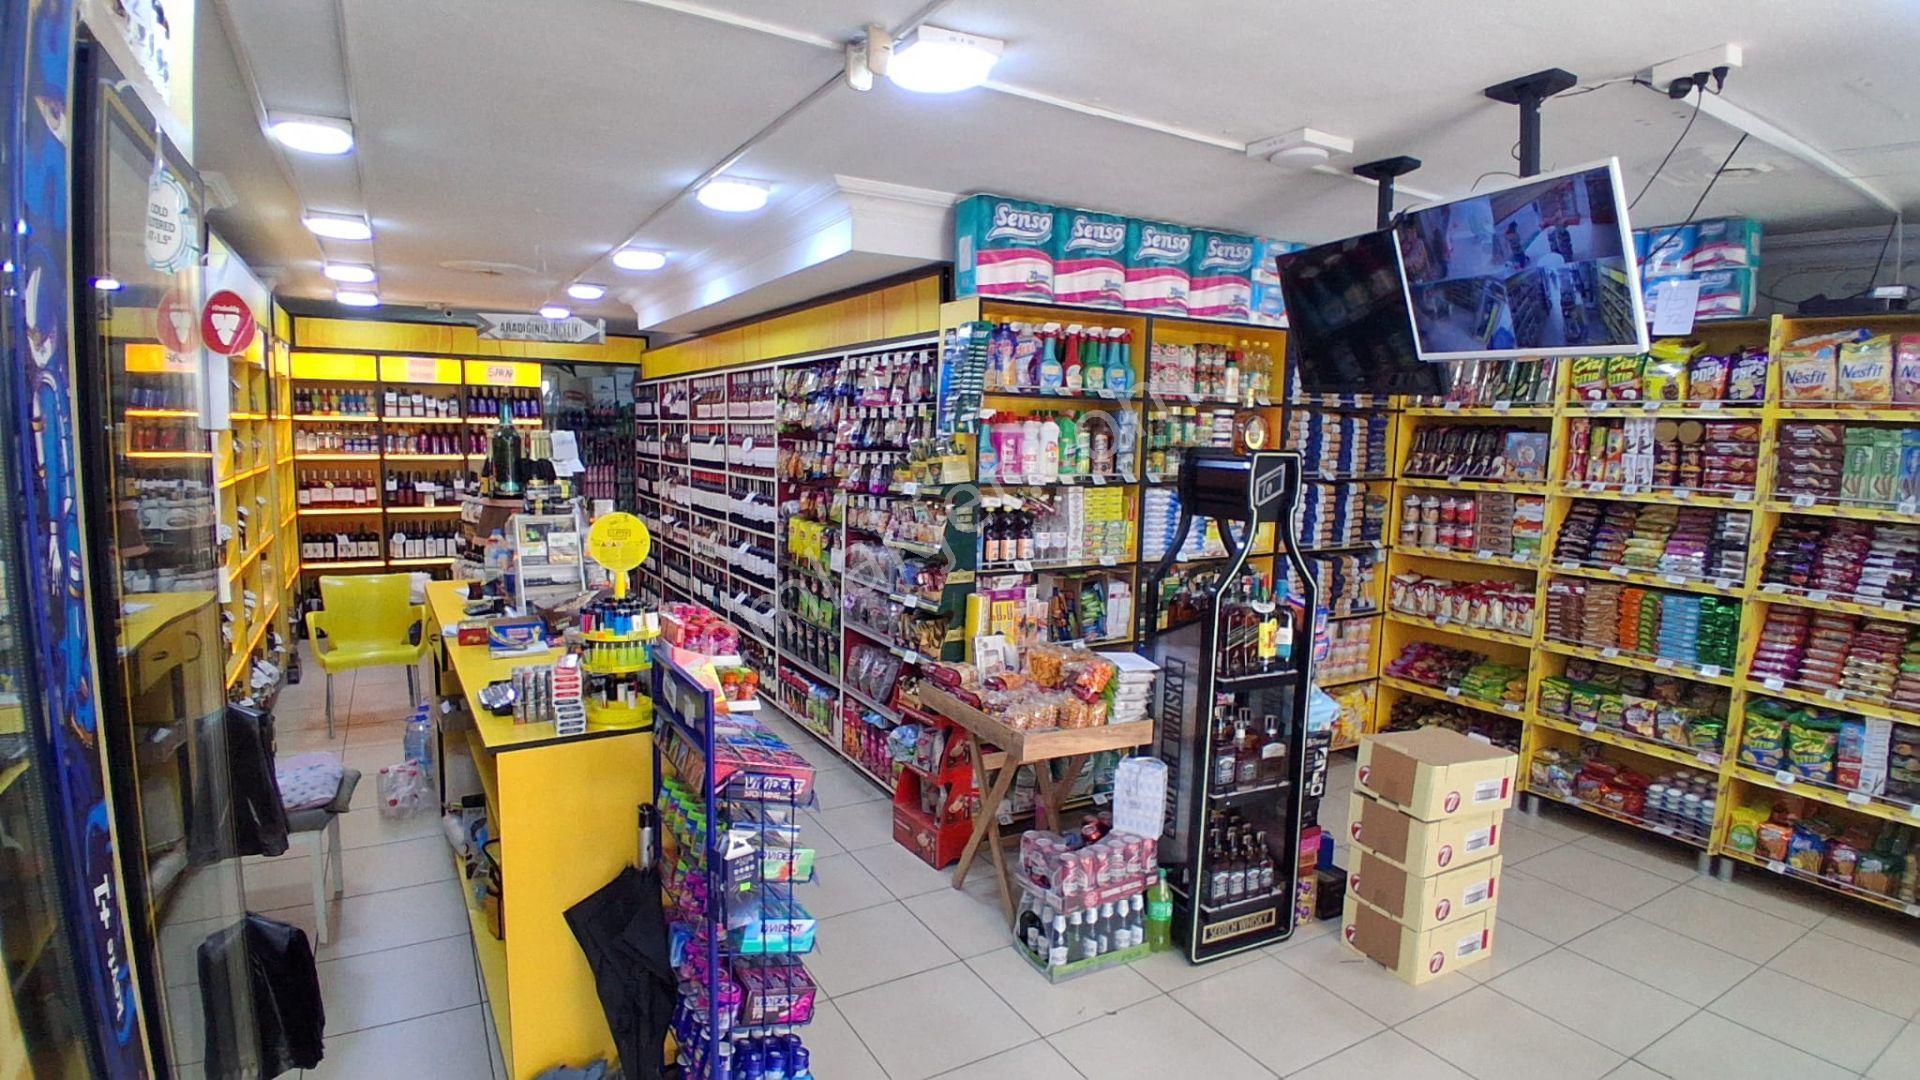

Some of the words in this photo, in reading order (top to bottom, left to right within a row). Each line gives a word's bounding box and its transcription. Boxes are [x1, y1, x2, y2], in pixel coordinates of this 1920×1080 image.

[995, 205, 1052, 231] Senso
[1073, 217, 1125, 242] Senso
[1143, 228, 1190, 252] Senso
[1207, 238, 1251, 261] Senso
[1786, 369, 1828, 387] Nesfit
[1841, 363, 1885, 380] Nesfit
